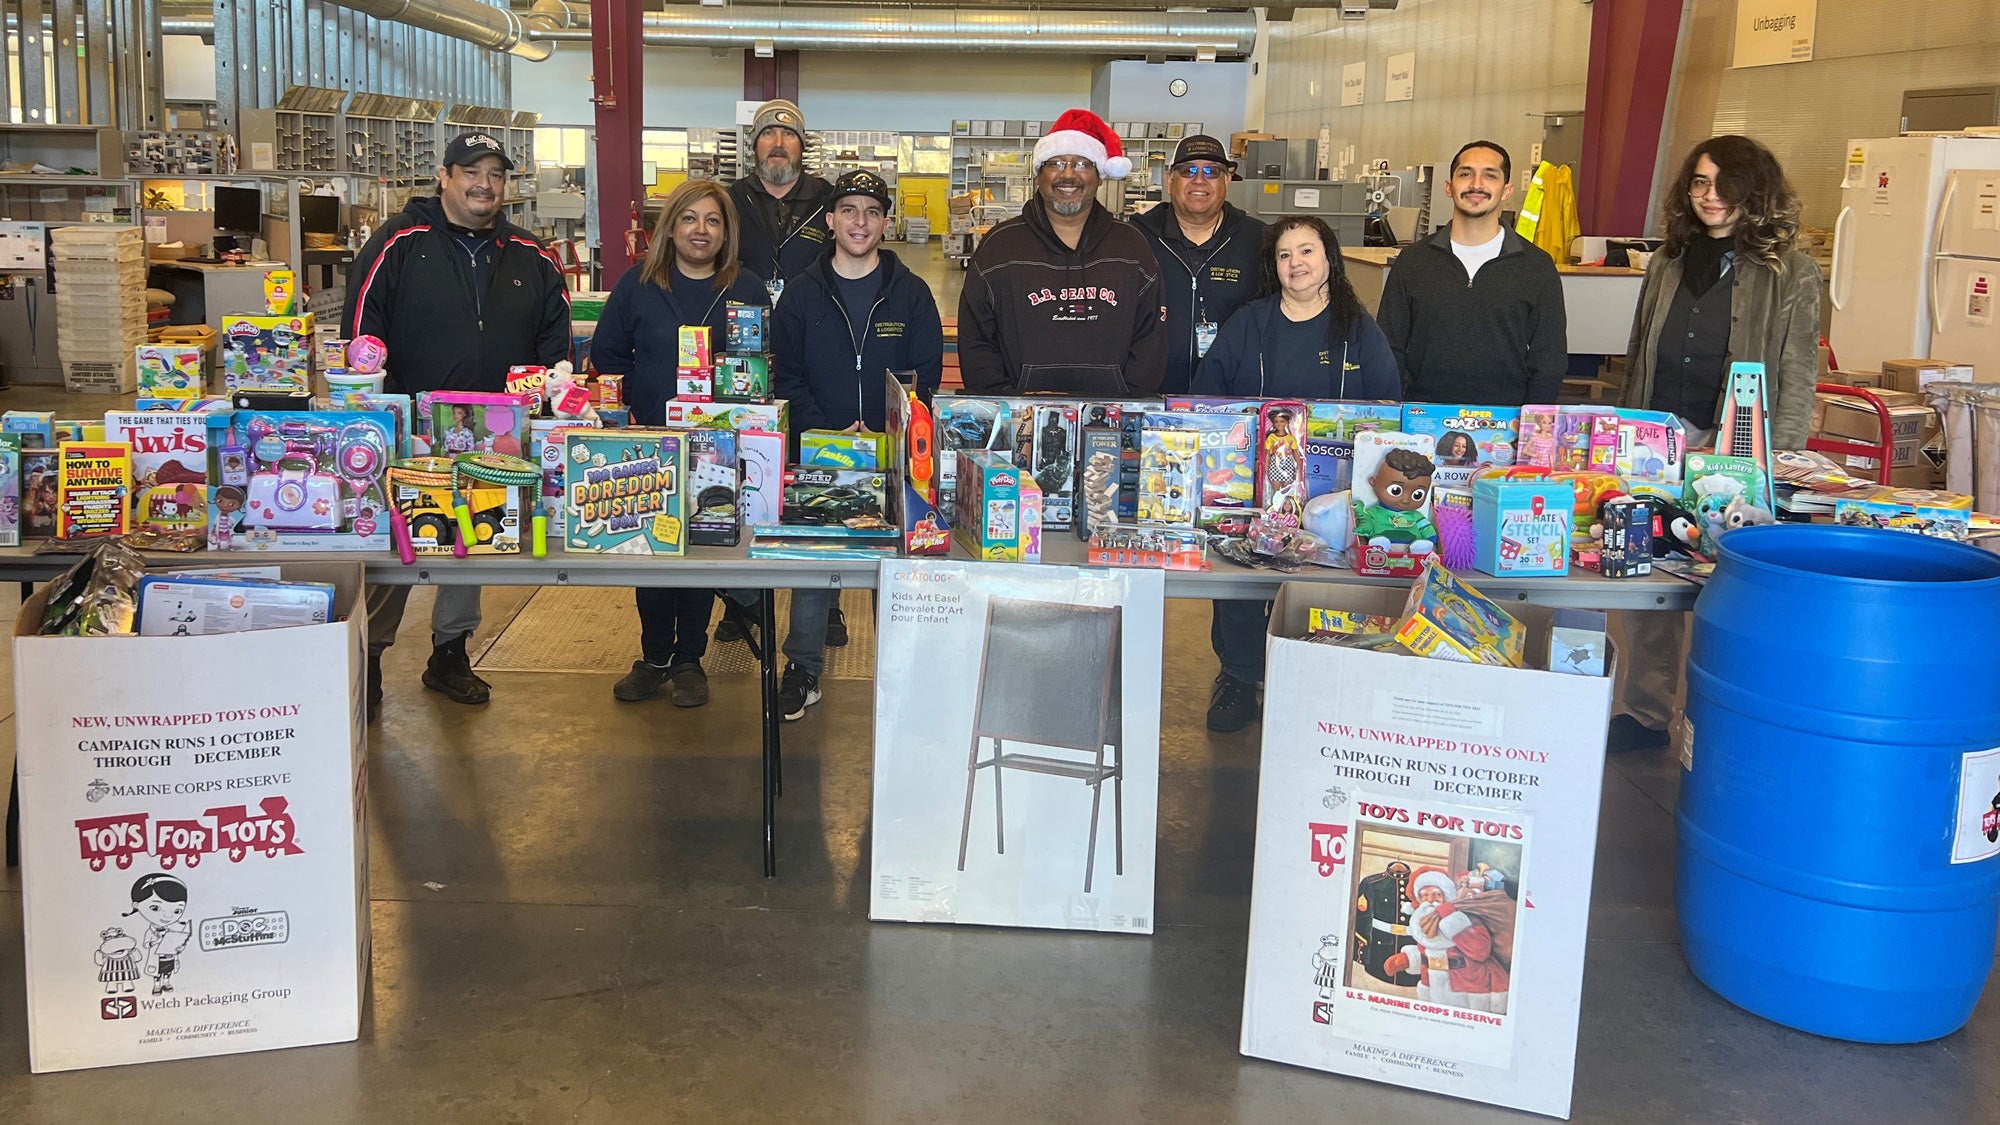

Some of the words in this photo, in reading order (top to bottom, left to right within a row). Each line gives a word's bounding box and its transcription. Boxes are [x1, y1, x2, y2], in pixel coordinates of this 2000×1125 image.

[1753, 14, 1796, 32] Unbagging
[1210, 266, 1240, 274] DISTRIUTION
[1060, 286, 1097, 300] JEAN
[1100, 288, 1118, 306] CO.
[506, 373, 545, 394] UNO
[118, 417, 131, 425] THE
[133, 417, 154, 425] GAME
[176, 416, 191, 424] TIES
[1459, 410, 1492, 418] SUPER
[1227, 422, 1248, 449] 4
[1892, 421, 1918, 435] GOBI
[120, 426, 206, 454] Twis
[688, 433, 715, 443] vable
[66, 461, 93, 470] HOW
[95, 460, 110, 468] TO
[66, 468, 122, 478] SURVIVE
[588, 469, 610, 482] 100
[612, 460, 658, 479] GAMES
[1313, 464, 1320, 474] 3
[1707, 463, 1723, 471] Kid's
[1725, 463, 1753, 474] Lantern
[66, 477, 123, 486] ANYTHING
[798, 473, 832, 481] SPEED
[1434, 472, 1441, 480] A
[1444, 472, 1470, 480] ROW
[576, 470, 672, 505] BOREDOM
[584, 492, 663, 522] BUSTER
[610, 513, 639, 530] BOX
[1514, 514, 1556, 522] ULTIMATE
[1507, 524, 1561, 536] STENCIL
[894, 568, 956, 582] CREATOLOGY
[892, 592, 913, 600] Kids
[916, 593, 932, 602] Art
[935, 594, 960, 603] Easel
[891, 603, 935, 613] Chevalet
[937, 606, 964, 615] D'Art
[891, 615, 914, 623] pour
[917, 615, 949, 624] Enfant
[72, 716, 111, 729] NEW,
[114, 713, 212, 728] UNWRAPPED
[216, 709, 256, 723] TOYS
[260, 704, 301, 718] ONLY
[78, 738, 161, 752] CAMPAIGN
[165, 736, 205, 750] RUNS
[210, 736, 216, 747] 1
[220, 728, 295, 746] OCTOBER
[1317, 721, 1355, 739] NEW,
[1358, 728, 1457, 752] UNWRAPPED
[1460, 742, 1502, 758] TOYS
[1505, 748, 1550, 764] ONLY
[93, 755, 171, 768] THROUGH
[194, 746, 281, 765] DECEMBER
[1320, 745, 1402, 769] CAMPAIGN
[1406, 759, 1446, 775] RUNS
[1451, 765, 1457, 776] 1
[1462, 766, 1540, 787] OCTOBER
[112, 784, 171, 797] MARINE
[174, 780, 222, 794] CORPS
[226, 772, 292, 790] RESERVE
[1334, 764, 1411, 787] THROUGH
[1434, 779, 1523, 802] DECEMBER
[1358, 802, 1410, 824] TOYS
[1417, 811, 1464, 832] FOR
[1471, 819, 1523, 840] TOTS
[82, 822, 144, 852] TOYS
[158, 826, 206, 850] FOR
[221, 819, 286, 844] TOTS
[223, 917, 267, 937] DOC
[214, 932, 276, 947] McStuffins
[141, 1000, 181, 1011] Welch
[185, 992, 249, 1007] Packaging
[251, 987, 292, 1002] Group
[1368, 994, 1410, 1009] MARINE
[1413, 1003, 1449, 1016] CORPS
[1453, 1010, 1502, 1026] RESERVE
[146, 1027, 183, 1037] MAKING
[193, 1020, 252, 1032] DIFFERENCE
[175, 1032, 217, 1041] COMMUNITY
[1345, 1050, 1369, 1060] FAMILY
[1381, 1057, 1422, 1071] COMMUNITY
[1352, 1044, 1388, 1056] MAKING
[1399, 1052, 1458, 1069] DIFFERENCE
